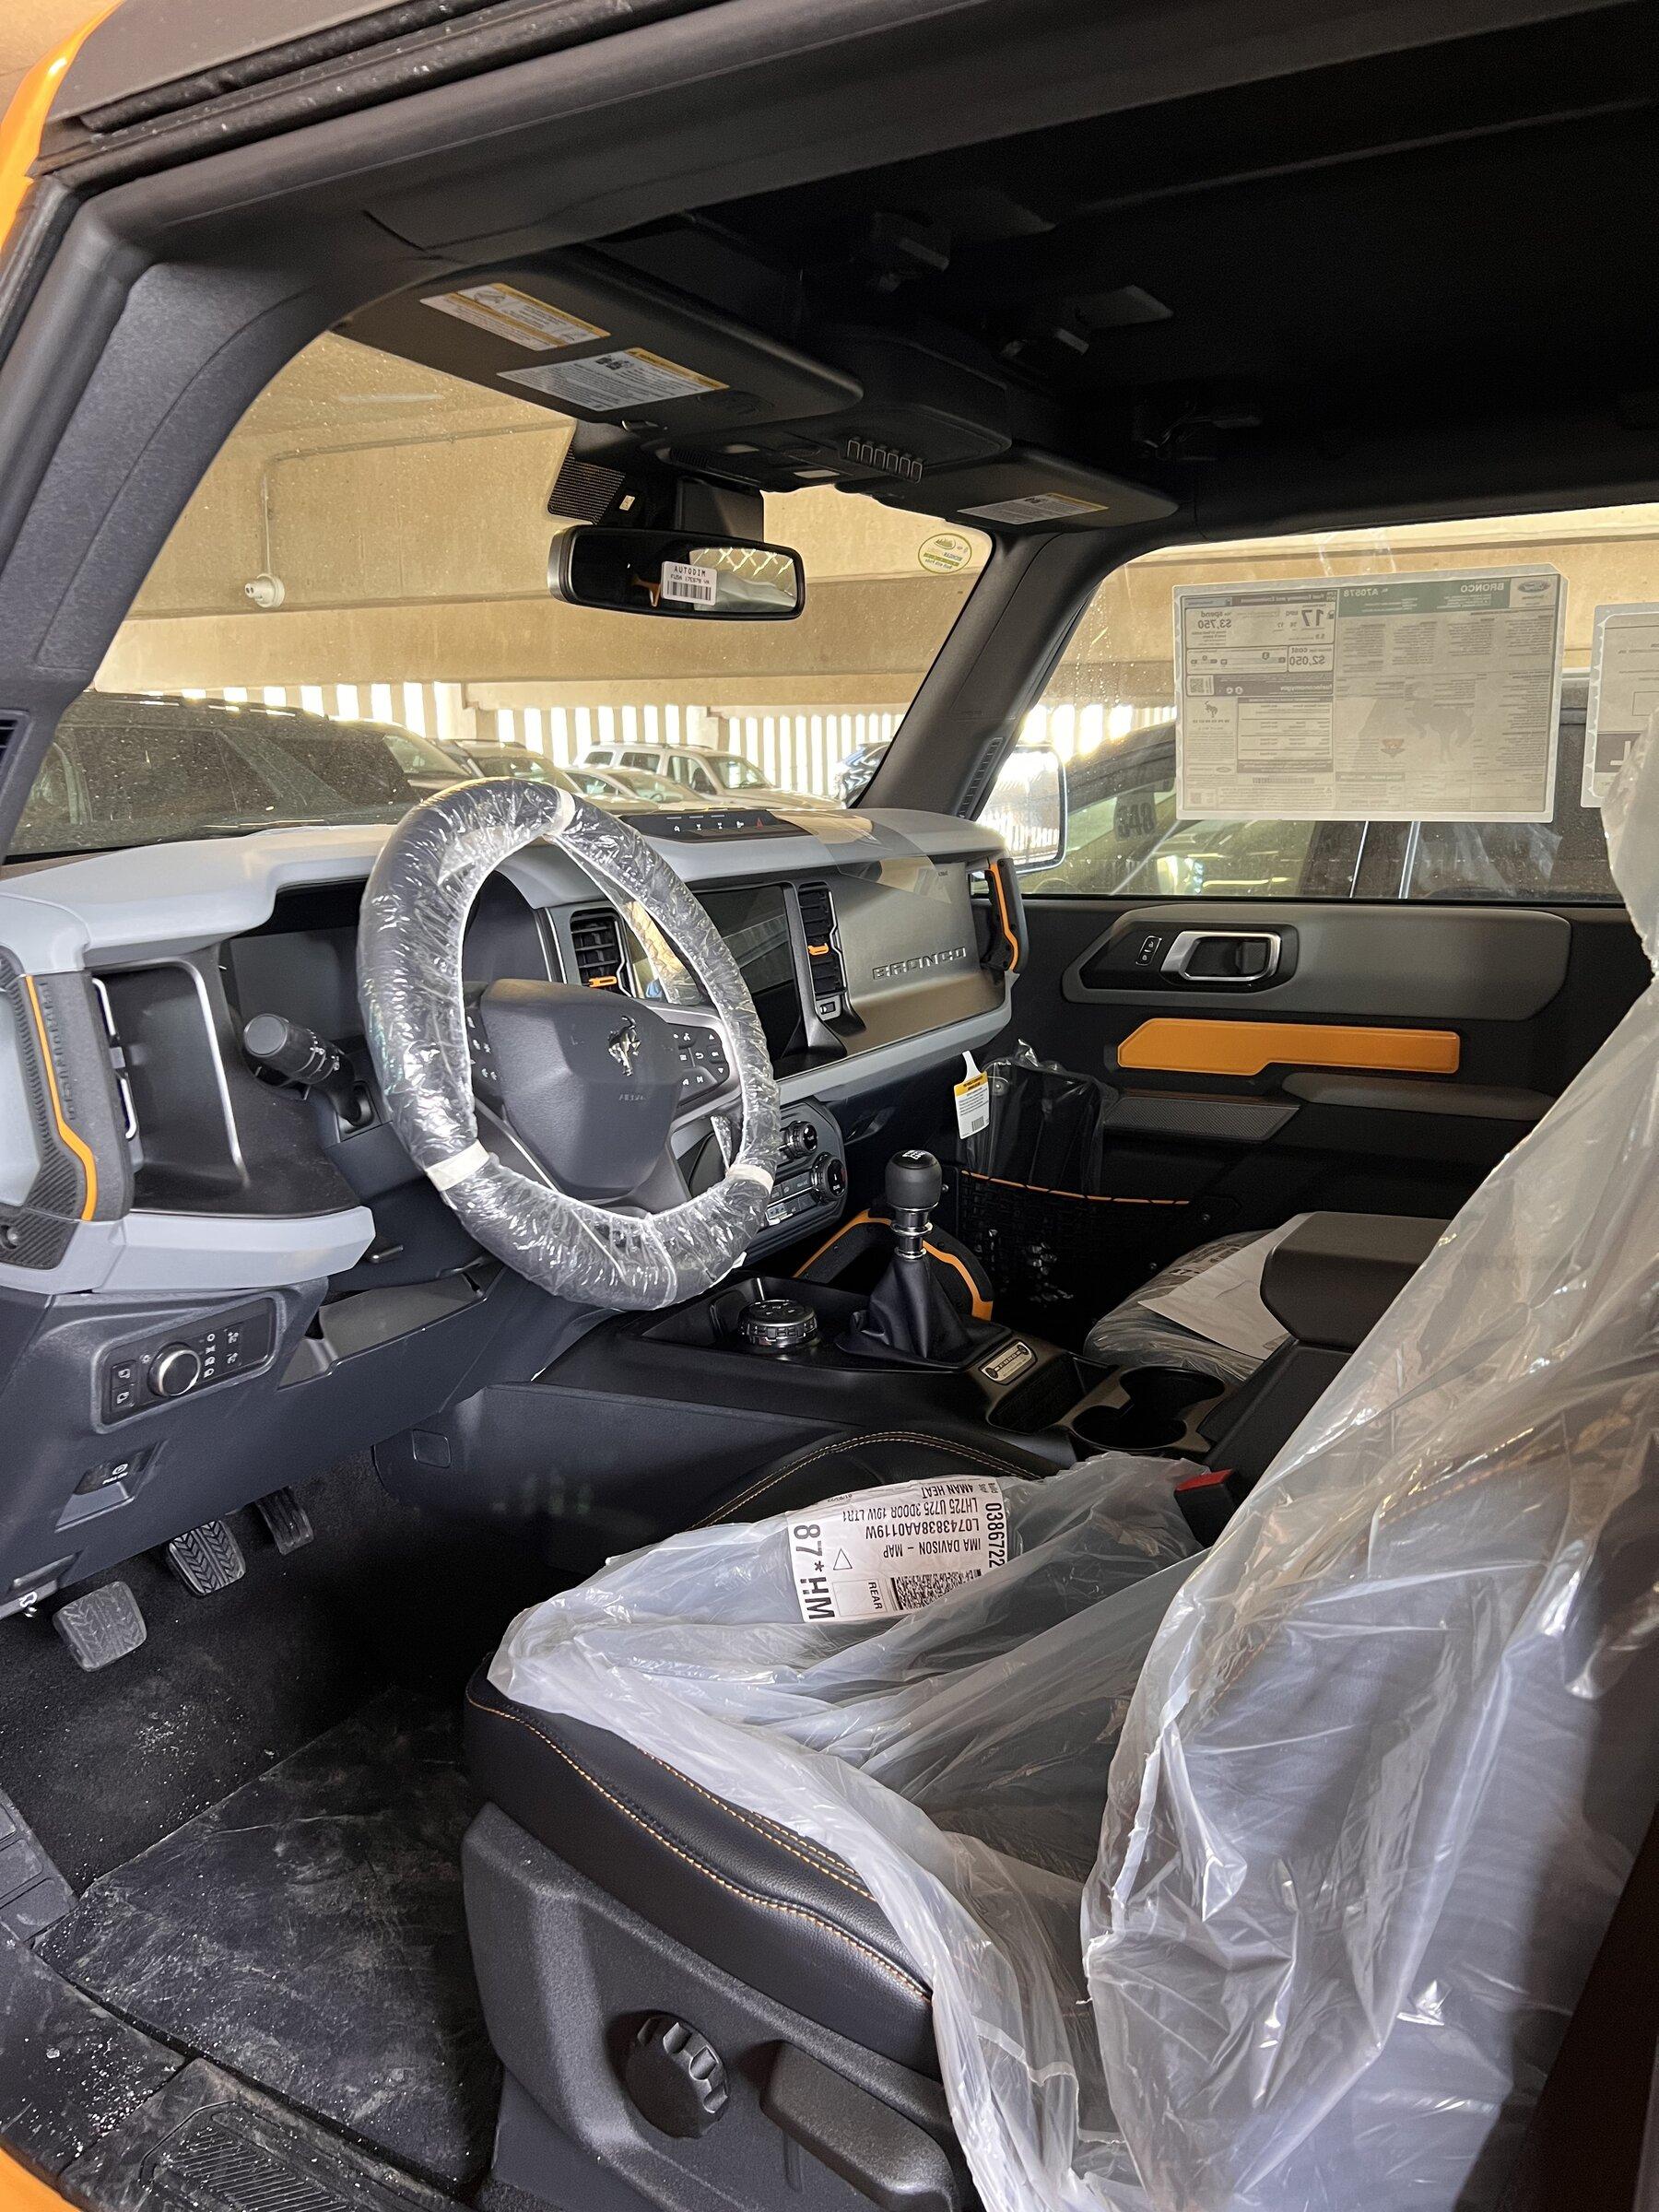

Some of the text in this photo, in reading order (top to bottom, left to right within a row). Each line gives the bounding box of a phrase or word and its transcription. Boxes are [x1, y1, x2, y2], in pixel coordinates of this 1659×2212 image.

[674, 565, 706, 577] AUTODIM
[872, 946, 967, 981] BRONCO
[921, 1486, 945, 1500] HEAT
[947, 1484, 974, 1497] 4MAN
[923, 1500, 947, 1516] U725
[948, 1497, 978, 1514] LH725
[865, 1518, 980, 1539] L0743838AA0119W
[984, 1502, 1006, 1569] 0386722
[882, 1544, 903, 1559] MAP
[918, 1539, 960, 1555] DAVISON
[963, 1537, 981, 1551] IMA
[867, 1582, 884, 1610] REAR
